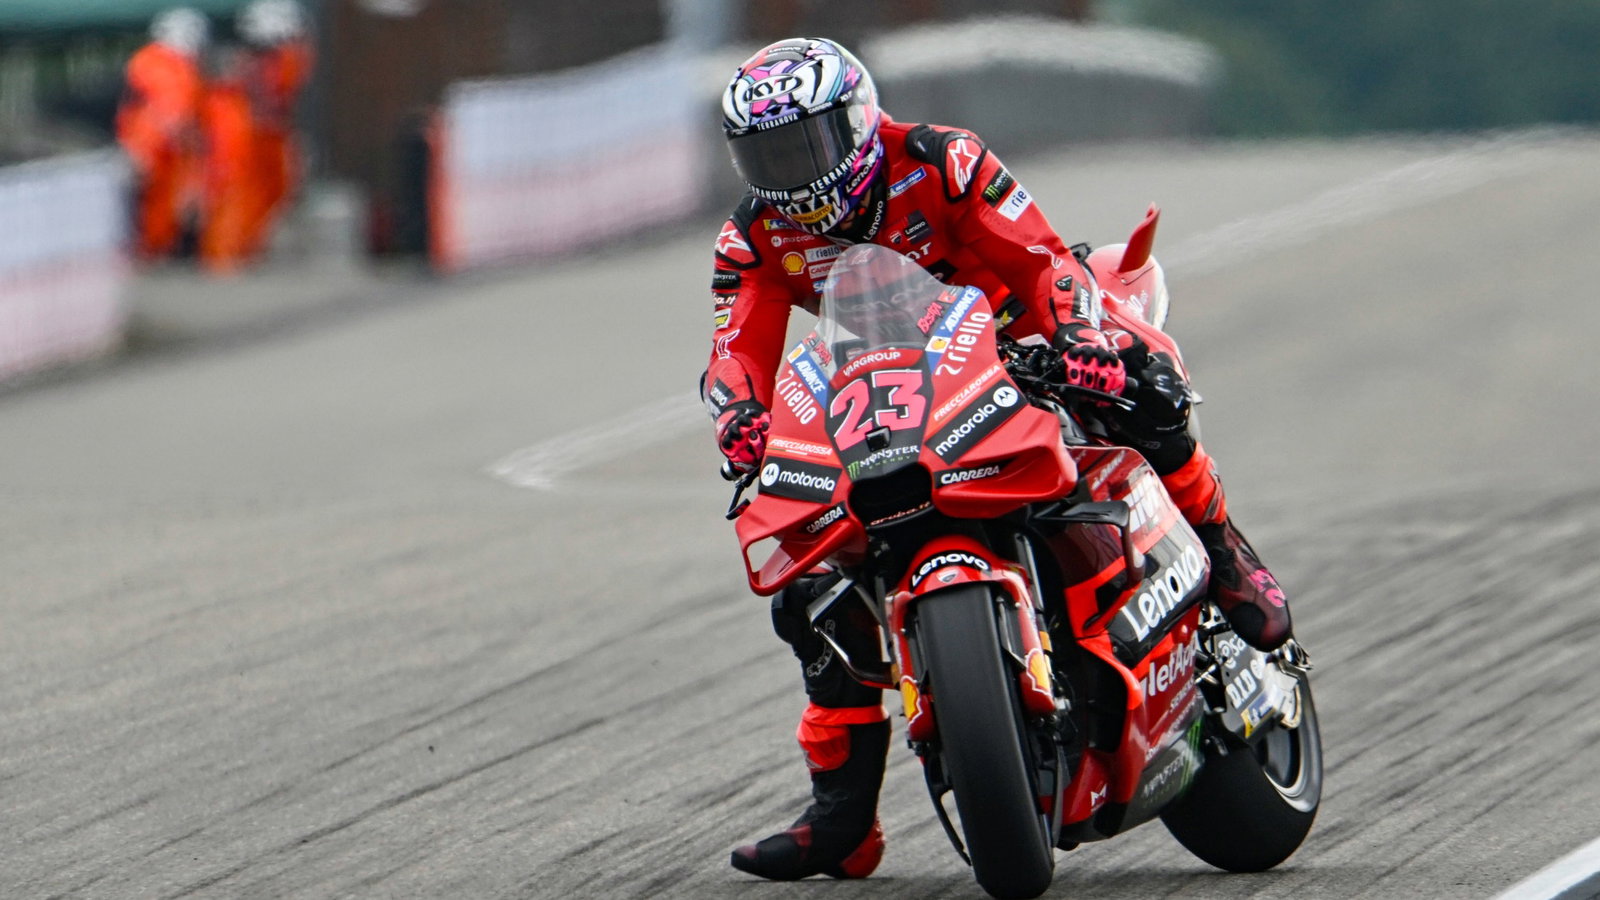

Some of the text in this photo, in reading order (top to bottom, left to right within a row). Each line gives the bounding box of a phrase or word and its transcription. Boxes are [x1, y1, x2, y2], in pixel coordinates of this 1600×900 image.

[756, 113, 799, 131] TERRANOVA
[809, 148, 861, 192] TERRANOVA
[863, 200, 884, 241] Lenovo
[905, 221, 926, 235] Lenovo
[945, 287, 980, 332] ADVANCE
[947, 311, 991, 362] riello
[783, 379, 817, 424] riello
[830, 369, 927, 451] 23
[933, 364, 1001, 421] FRECCIAROSSA
[769, 438, 833, 456] FRECCIAROSSA
[935, 403, 998, 456] motorola
[860, 445, 920, 467] MONSTER
[940, 465, 1000, 485] CARRERA
[778, 470, 836, 492] motorola
[806, 506, 845, 534] CARRERA
[911, 553, 989, 588] Lenovo
[1121, 545, 1200, 641] Lenovo
